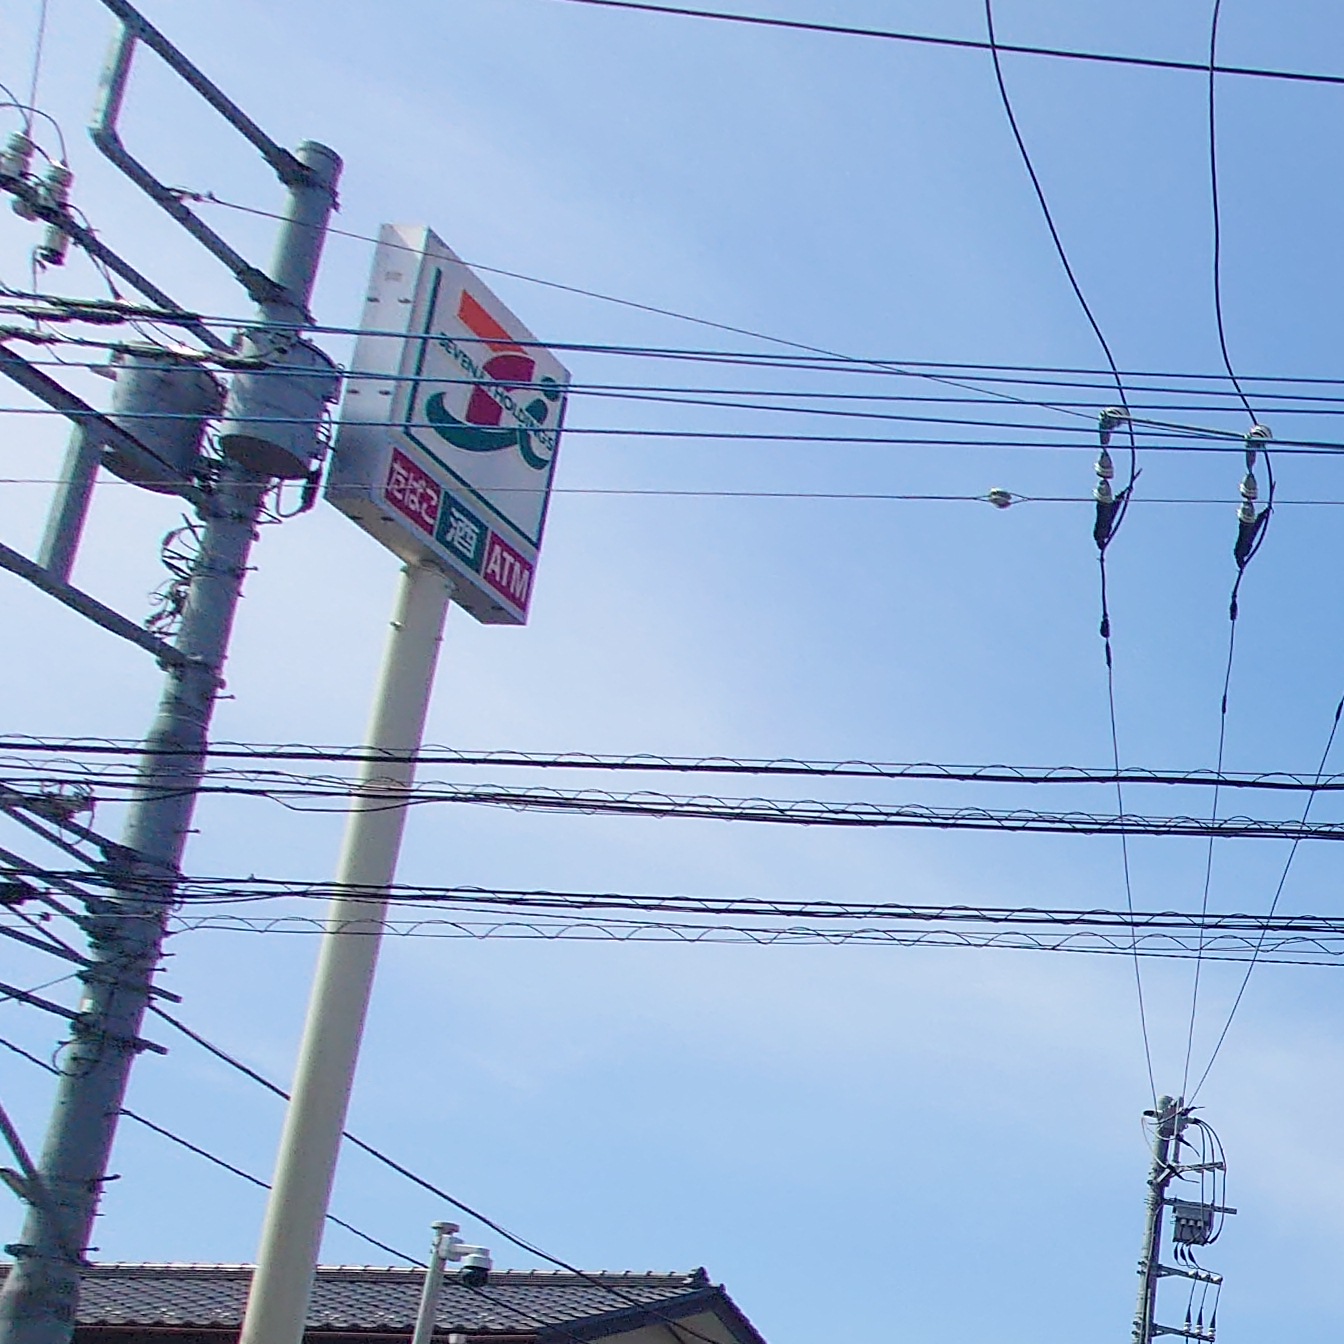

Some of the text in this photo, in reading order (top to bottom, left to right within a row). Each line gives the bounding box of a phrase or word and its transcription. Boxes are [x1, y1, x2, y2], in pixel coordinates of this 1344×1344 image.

[391, 462, 438, 525] たばこ
[446, 507, 480, 559] 酒
[487, 544, 531, 602] ATM
